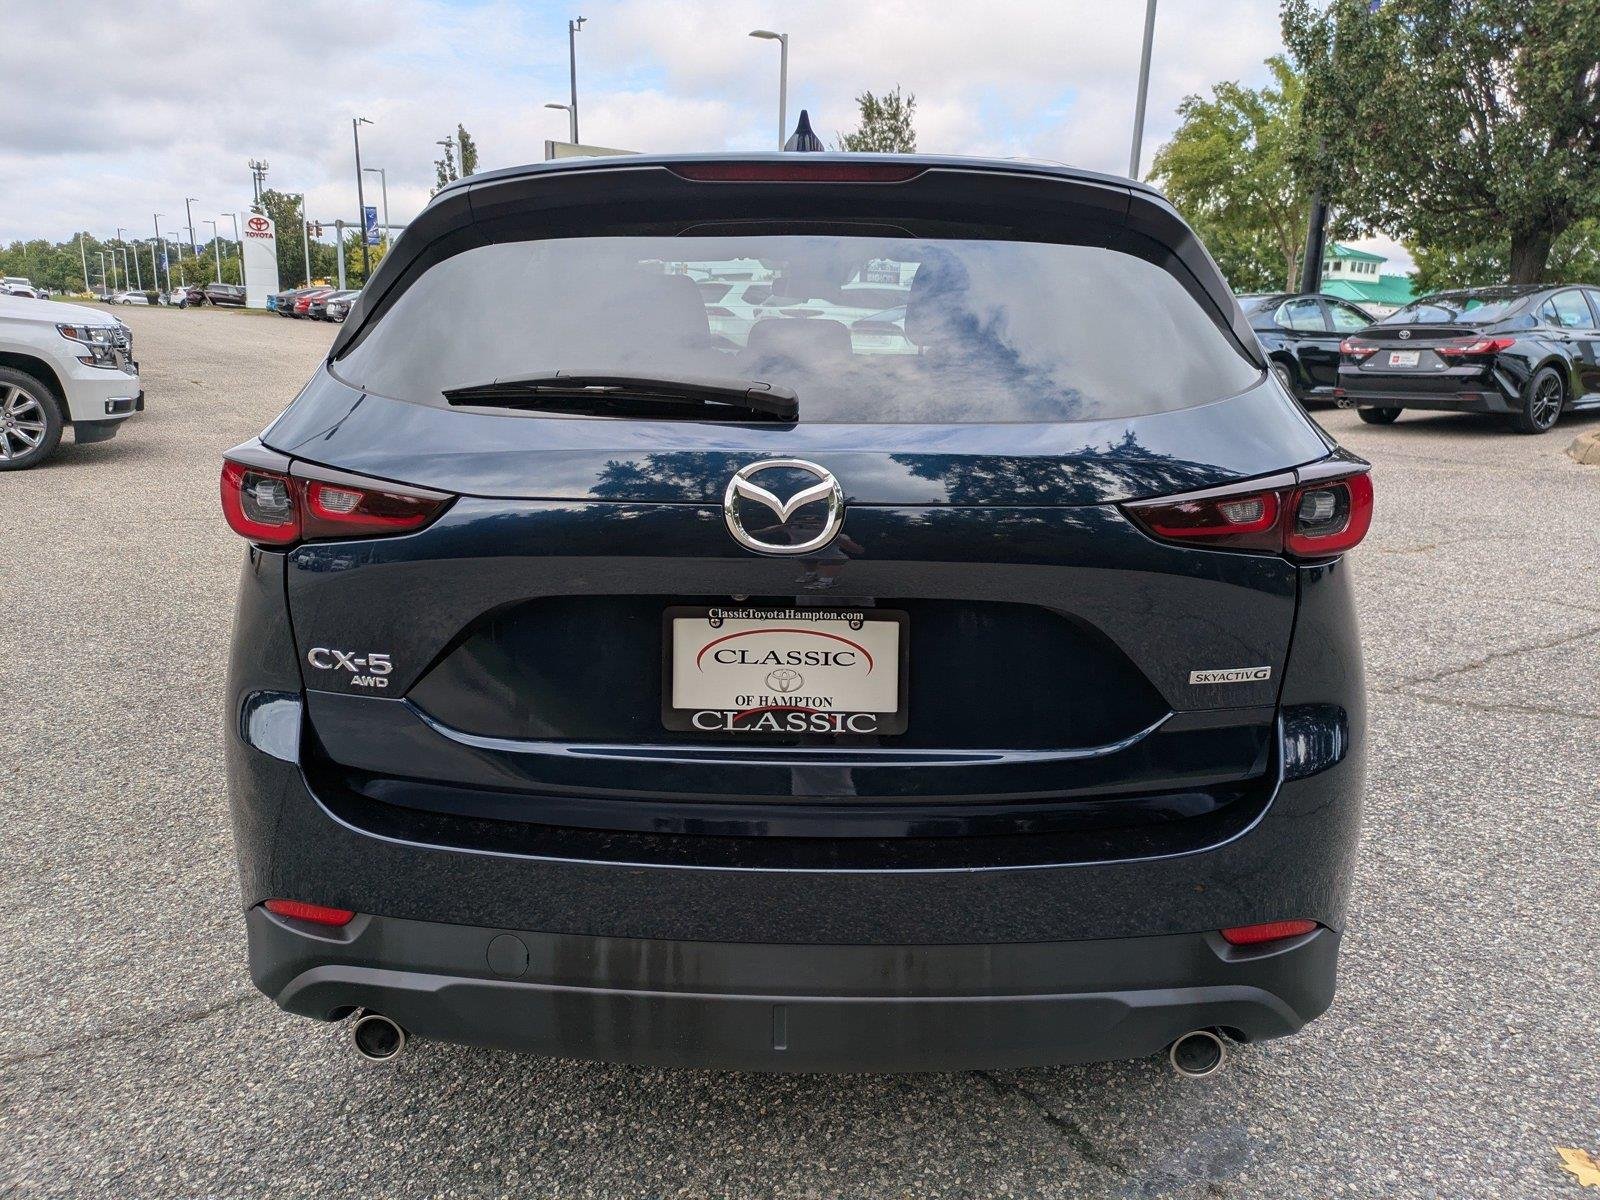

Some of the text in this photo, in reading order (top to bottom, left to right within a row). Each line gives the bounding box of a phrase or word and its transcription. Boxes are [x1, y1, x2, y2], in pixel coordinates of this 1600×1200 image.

[245, 231, 274, 239] TOYOTA
[708, 608, 864, 621] ClassicToyotaHampton.com
[307, 647, 393, 675] CX-5
[714, 649, 856, 667] CLASSIC
[350, 675, 389, 688] AWD
[735, 695, 833, 708] OF HAMPTON
[692, 710, 878, 733] CLASSIC
